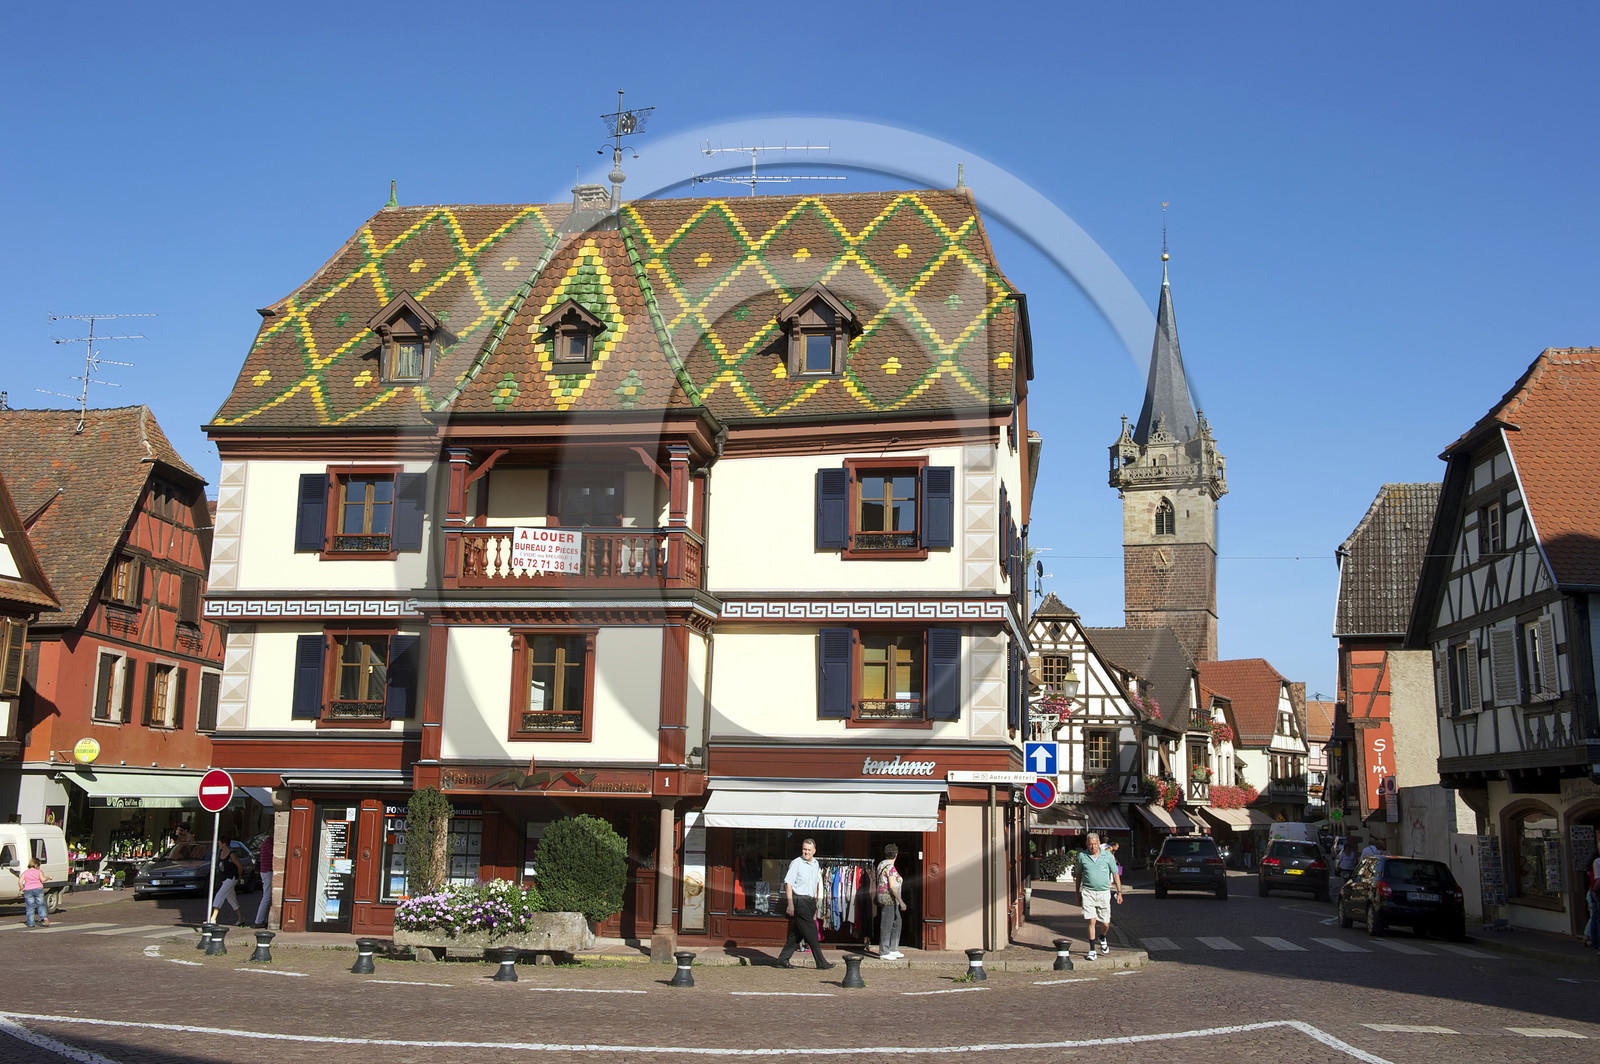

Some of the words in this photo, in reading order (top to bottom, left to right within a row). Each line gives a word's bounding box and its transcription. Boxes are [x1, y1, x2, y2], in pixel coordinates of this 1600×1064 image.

[520, 530, 528, 540] A
[533, 531, 574, 543] LOUER
[515, 542, 546, 552] BUREAU
[548, 545, 553, 553] 2
[513, 557, 524, 567] 06
[527, 558, 537, 568] 72
[541, 559, 550, 569] 71
[554, 561, 565, 570] 38
[569, 562, 579, 571] 14
[862, 755, 936, 776] tendance
[664, 777, 670, 787] 1
[793, 815, 846, 829] tendance
